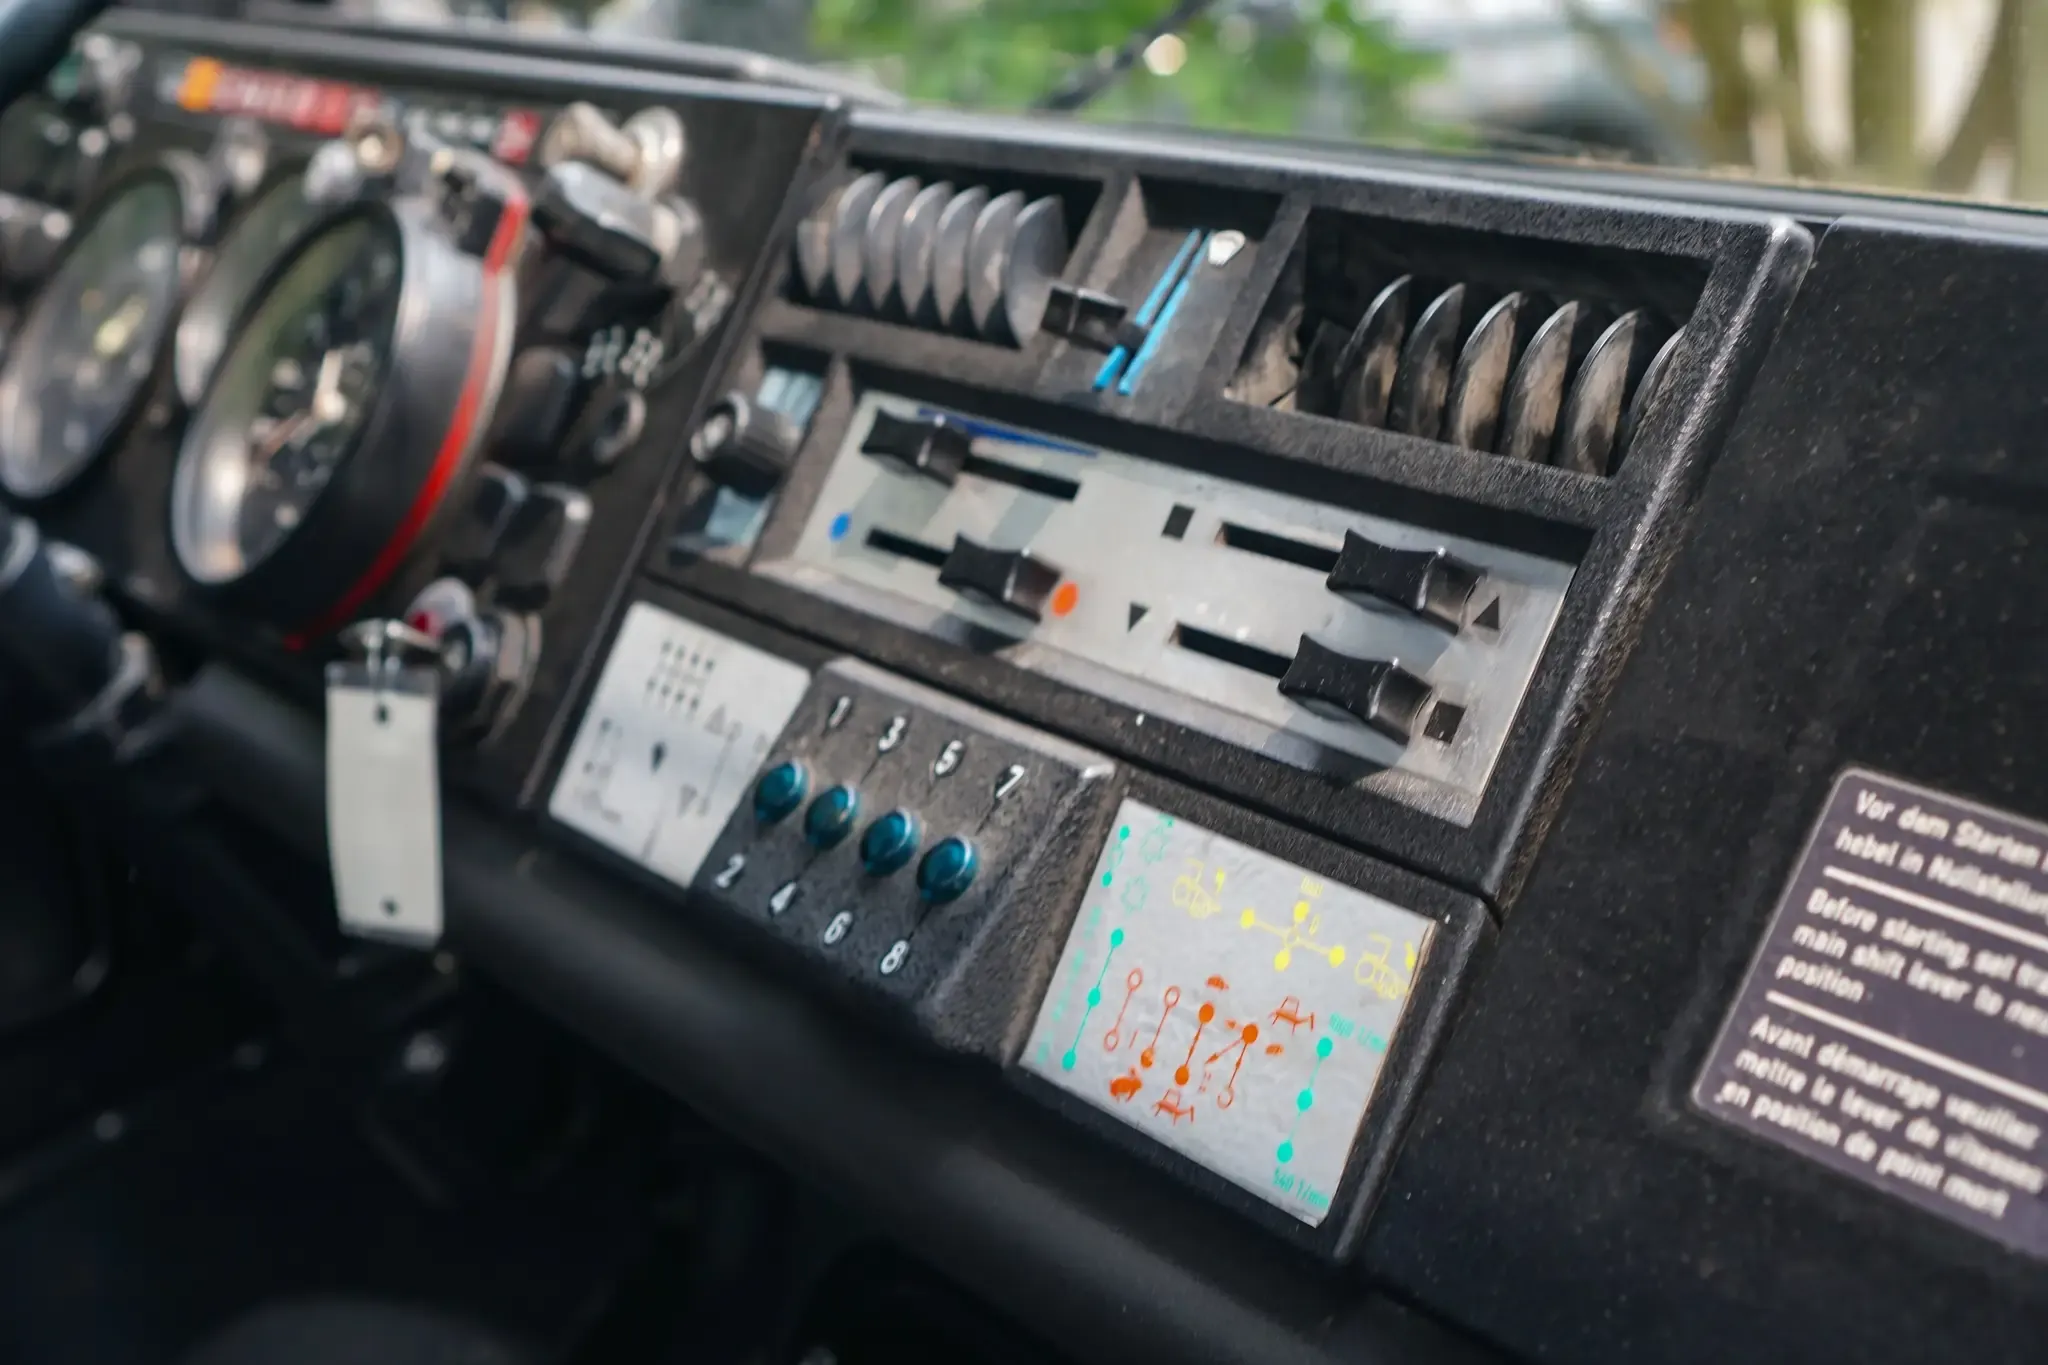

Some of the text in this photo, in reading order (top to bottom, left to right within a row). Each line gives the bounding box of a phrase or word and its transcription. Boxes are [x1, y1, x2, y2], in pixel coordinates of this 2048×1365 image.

[830, 696, 1025, 799] 1 3 5 7
[1834, 825, 1900, 867] hebel
[1898, 846, 1924, 875] in
[1927, 853, 2048, 925] Nullstellun
[1856, 789, 1895, 821] Vor
[1897, 804, 1951, 841] dem
[1952, 819, 2041, 869] Starten
[715, 852, 908, 975] 2 4 6 8
[1806, 887, 1878, 933] Before
[1973, 949, 2017, 982] set
[1774, 954, 1865, 1004] position
[1792, 924, 1848, 960] main
[1850, 943, 1906, 981] shift
[1906, 959, 1973, 1004] lever
[1972, 983, 2004, 1017] to
[1749, 1013, 1816, 1060] Avant
[1720, 1080, 1751, 1108] en
[1751, 1093, 1842, 1148] position
[1843, 1129, 1878, 1163] de
[1876, 1145, 1945, 1191] point
[1734, 1049, 1808, 1094] mettre
[1810, 1073, 1837, 1107] le
[1904, 1115, 1941, 1149] de
